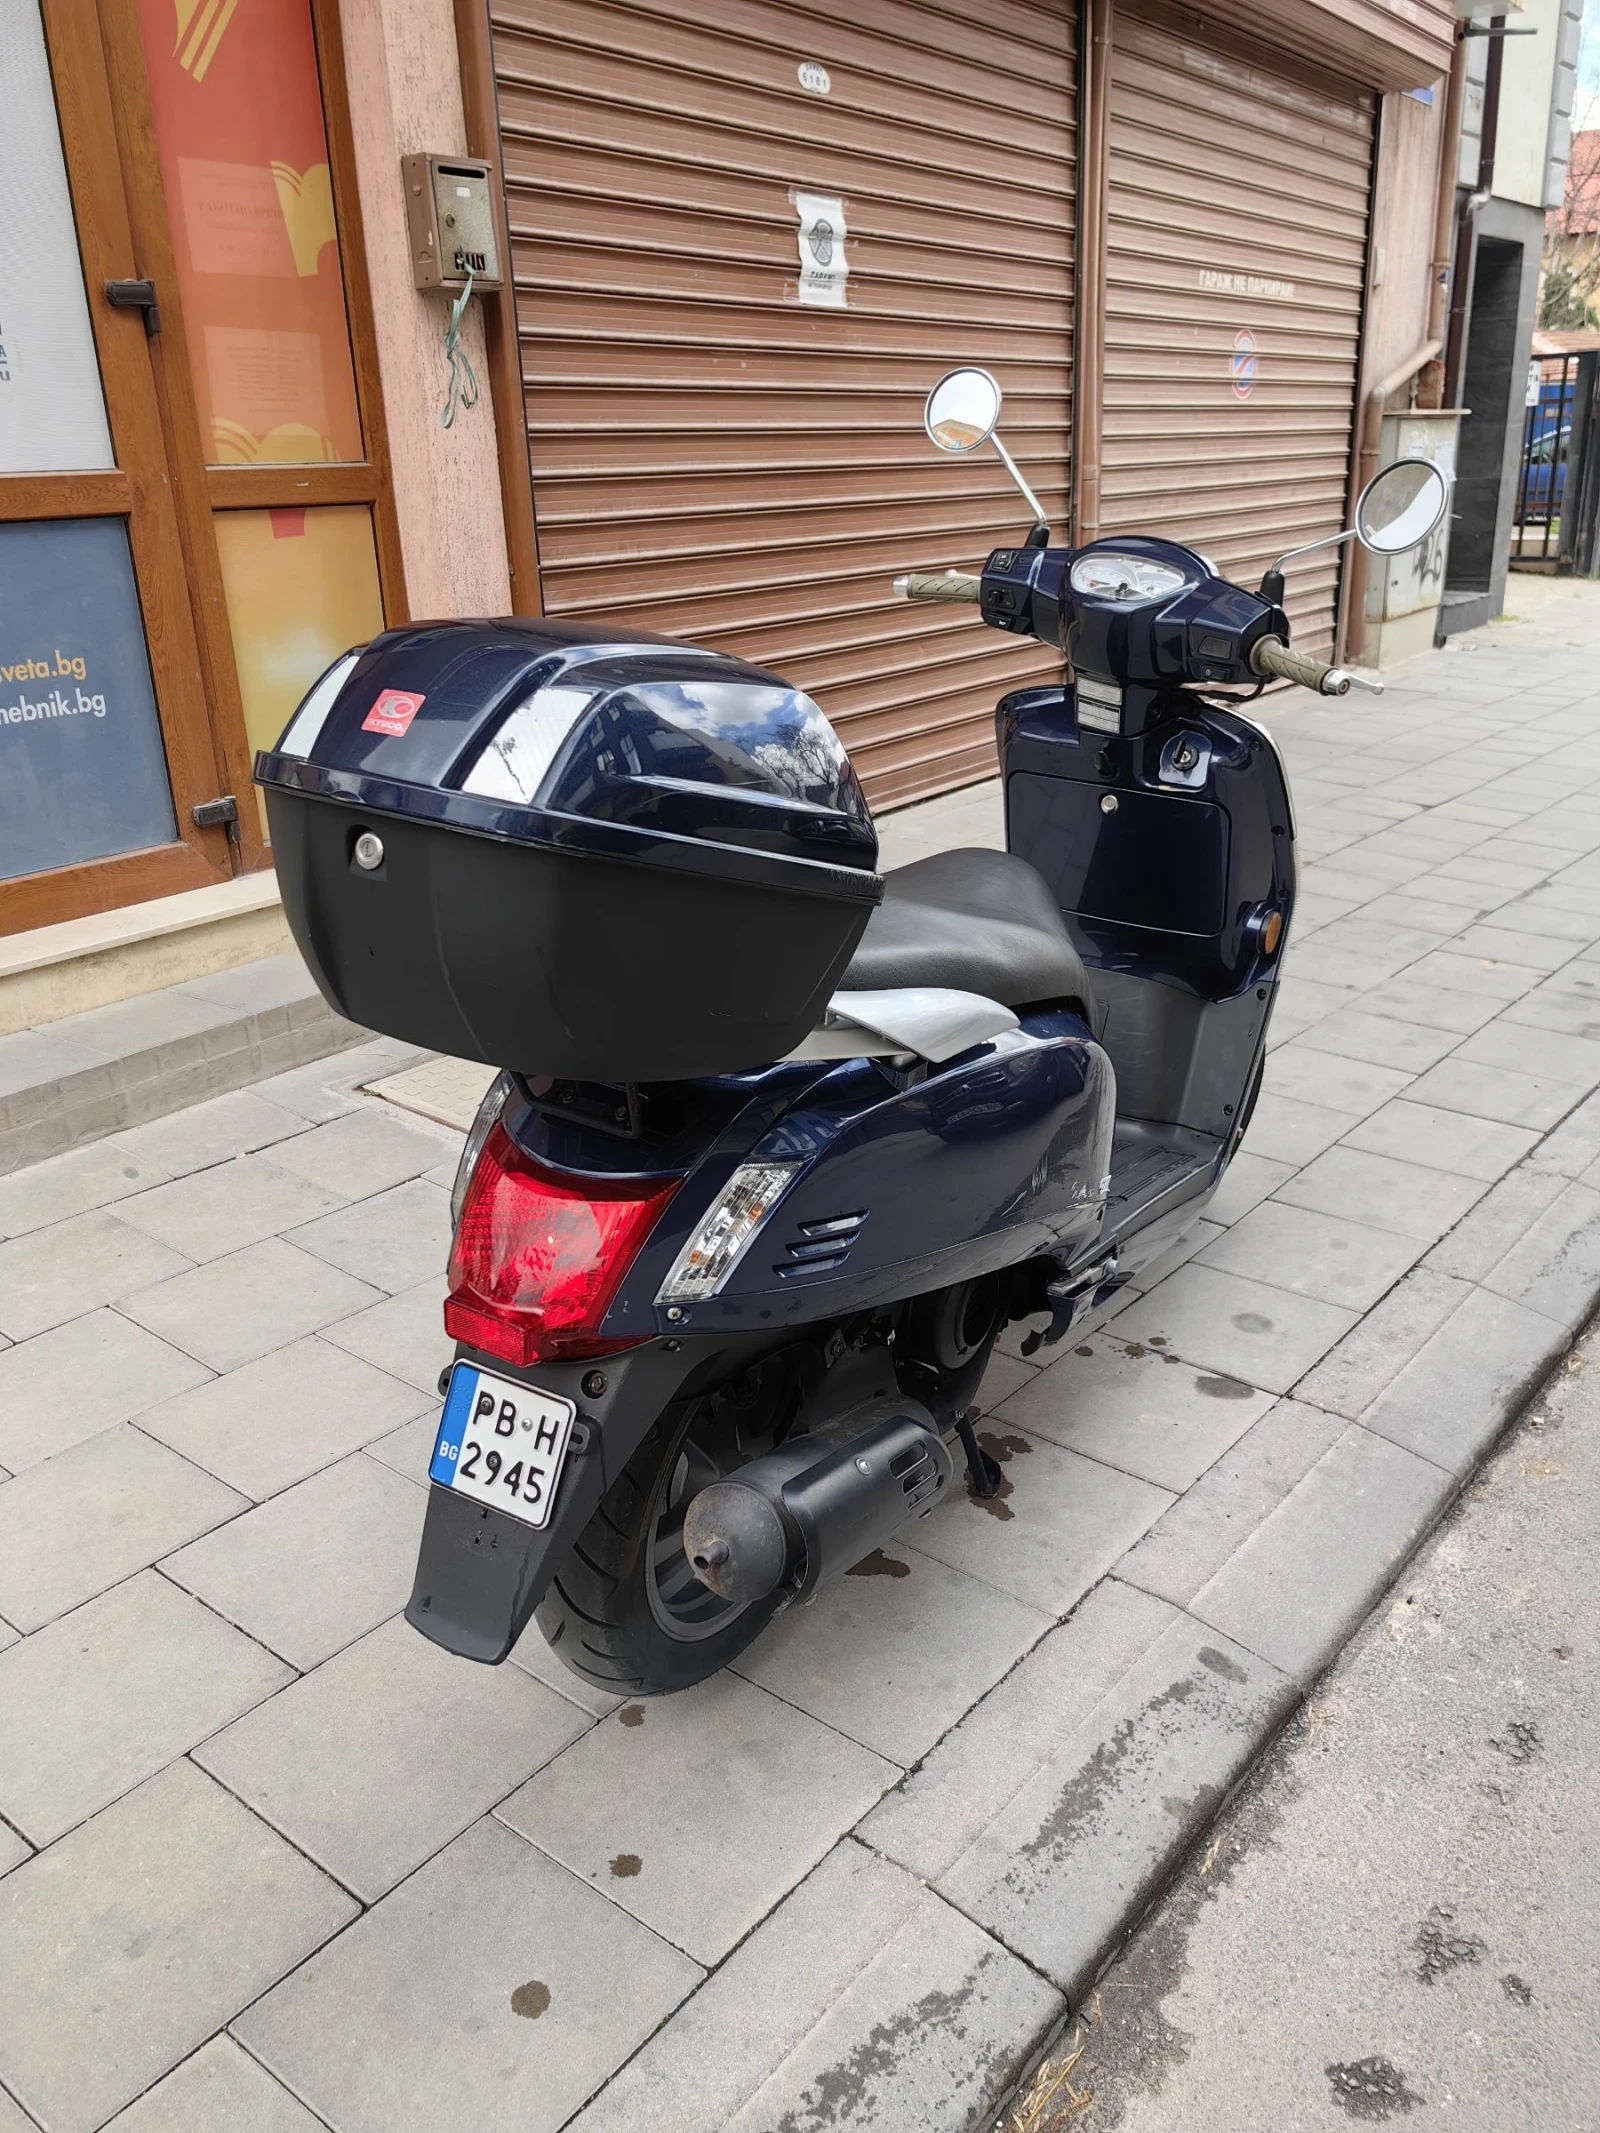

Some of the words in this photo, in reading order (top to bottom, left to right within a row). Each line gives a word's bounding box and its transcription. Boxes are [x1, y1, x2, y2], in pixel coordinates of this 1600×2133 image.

[1199, 270, 1233, 290] ГАРАЖ
[1234, 275, 1247, 292] НЕ
[472, 1390, 517, 1438] PB
[533, 1414, 560, 1456] H
[439, 1440, 458, 1461] BG
[460, 1441, 545, 1504] 2945
